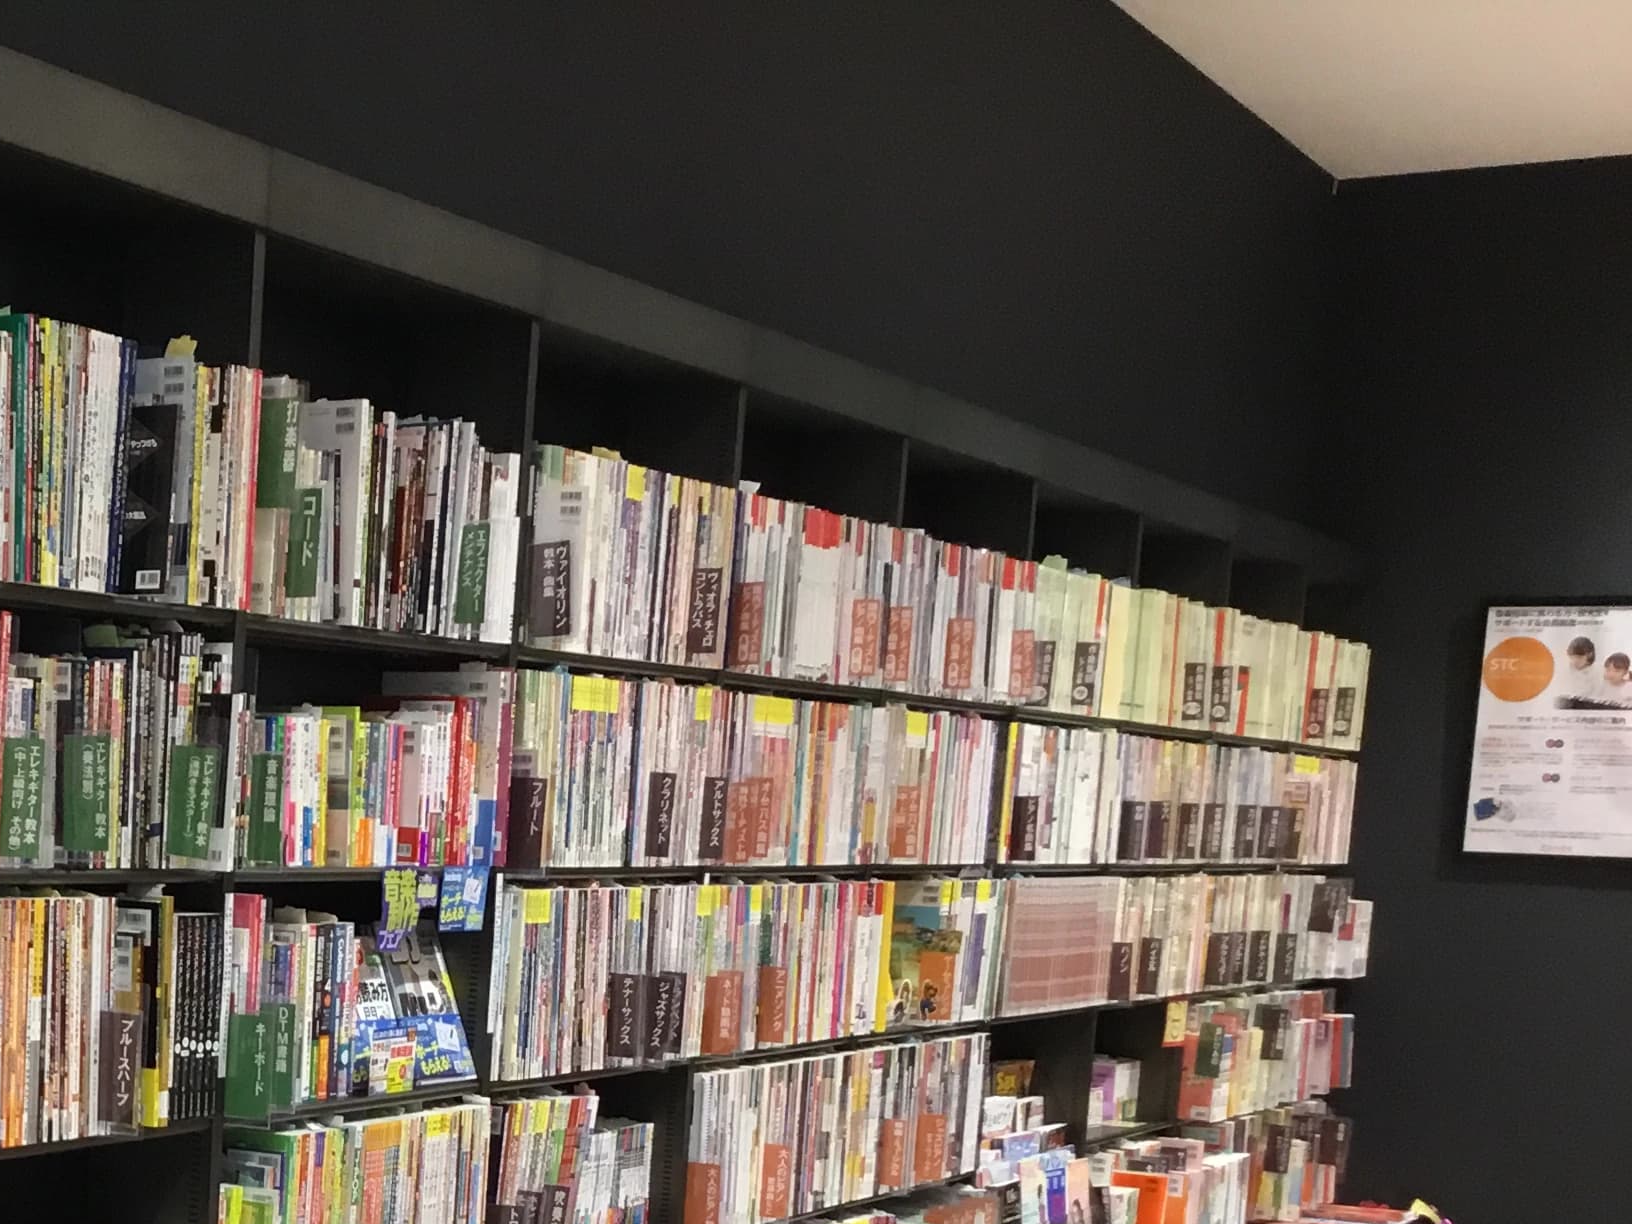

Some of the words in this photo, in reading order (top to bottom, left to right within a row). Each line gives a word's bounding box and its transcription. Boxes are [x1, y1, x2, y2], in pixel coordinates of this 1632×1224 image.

[301, 497, 316, 566] コード
[472, 530, 486, 611] エフェクター
[554, 547, 568, 628] ヴァイオリン
[692, 572, 705, 628] コントラバス
[1488, 659, 1519, 671] STC
[23, 745, 41, 845] エレキギター教本
[95, 742, 107, 839] エレキギター教本
[195, 755, 214, 847] エレキギター教本
[530, 782, 542, 835] フルート
[658, 777, 670, 843] クラリネット
[709, 781, 724, 846] アルトサックス
[378, 929, 404, 949] フェア
[620, 978, 634, 1044] テナーサックス
[650, 981, 669, 1047] ジャズサックス
[772, 970, 785, 1032] アニメソング
[117, 1019, 133, 1106] ブルースハープ
[254, 1023, 266, 1096] キーボード
